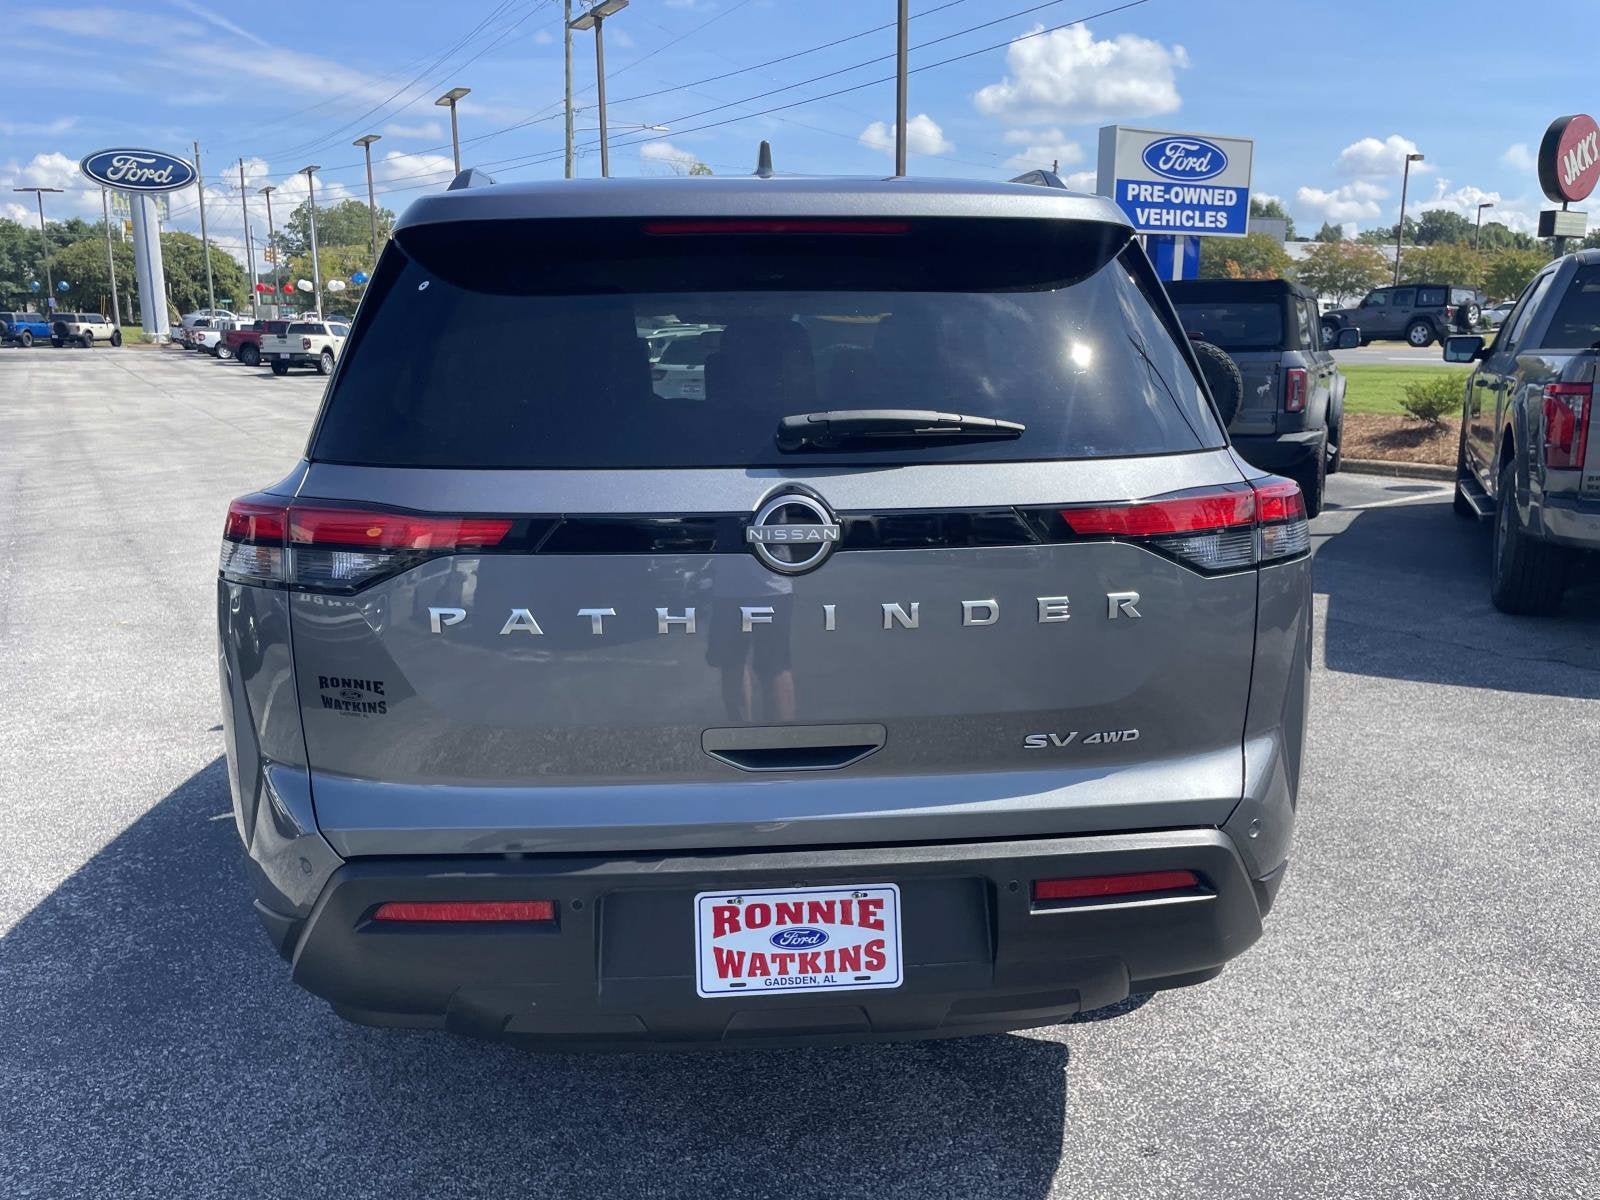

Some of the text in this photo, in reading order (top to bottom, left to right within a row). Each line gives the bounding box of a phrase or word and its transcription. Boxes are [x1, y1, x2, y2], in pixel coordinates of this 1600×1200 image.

[1158, 142, 1211, 172] Ford
[1563, 131, 1599, 186] JACK'S
[106, 155, 173, 183] Ford
[1127, 183, 1238, 206] PRE-OWNED
[1136, 208, 1228, 228] VEHICLES
[749, 528, 837, 540] NISSAN
[427, 591, 1142, 635] PATHFINDER
[318, 675, 385, 696] RONNIE
[321, 694, 387, 714] WATKINS
[1023, 729, 1140, 748] SV 4WD
[712, 898, 885, 939] RONNIE
[779, 929, 821, 946] Ford
[713, 938, 886, 979] WATKINS
[764, 975, 838, 987] GADSDEN, AL
